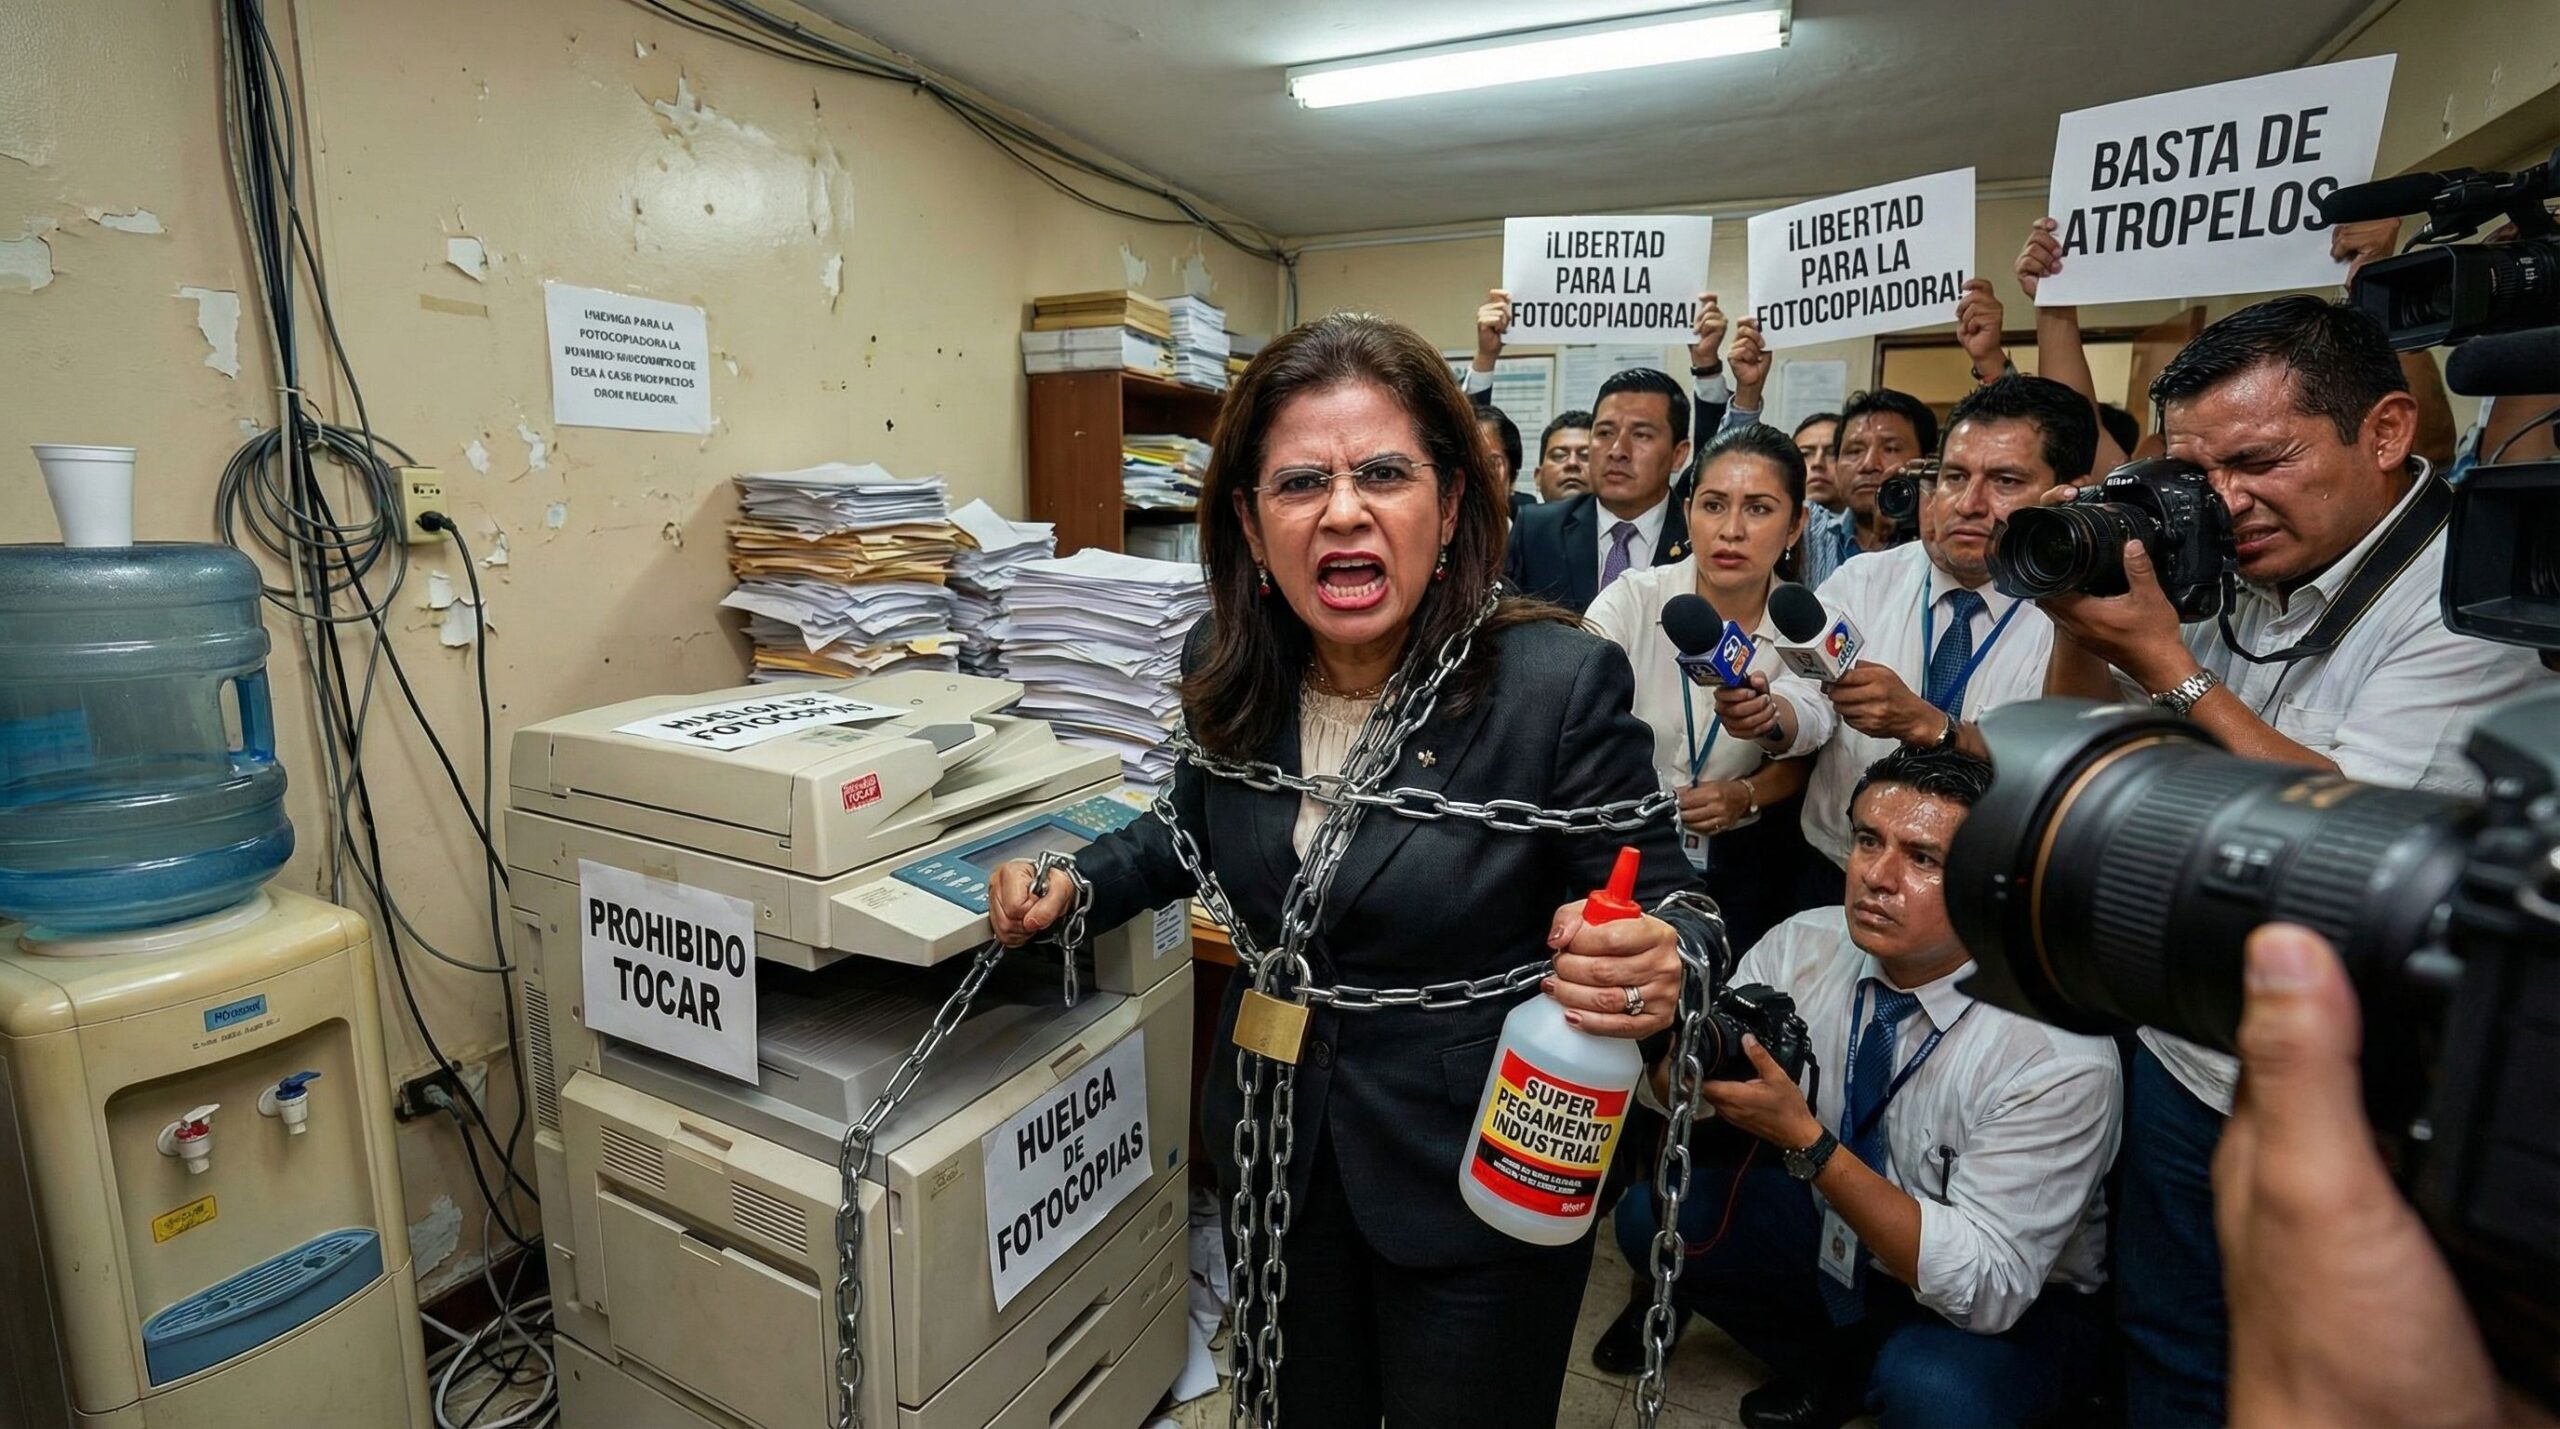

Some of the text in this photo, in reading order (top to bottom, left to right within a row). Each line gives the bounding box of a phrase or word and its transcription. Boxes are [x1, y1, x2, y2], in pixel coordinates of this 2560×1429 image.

[2091, 106, 2329, 192] BASTA DE
[1546, 231, 1665, 259] ¡LIBERTAD
[1788, 194, 1924, 252] ¡LIBERTAD
[2061, 176, 2339, 257] ATROPELOS
[1556, 266, 1651, 294] PARA LA
[1801, 238, 1911, 289] PARA LA
[1510, 302, 1697, 329] FOTOCOPIADORA!
[1757, 269, 1964, 333] FOTOCOPIADORA!
[589, 897, 746, 979] PROHIBIDO
[613, 956, 723, 1032] TOCAR
[1016, 1066, 1117, 1171] HUELGA
[1497, 1086, 1612, 1142] PEGAMENTO
[1525, 1079, 1596, 1119] SUPER
[1063, 1134, 1085, 1173] DE
[1492, 1109, 1601, 1164] INDUSTRIAL
[996, 1121, 1144, 1273] FOTOCOPIAS
